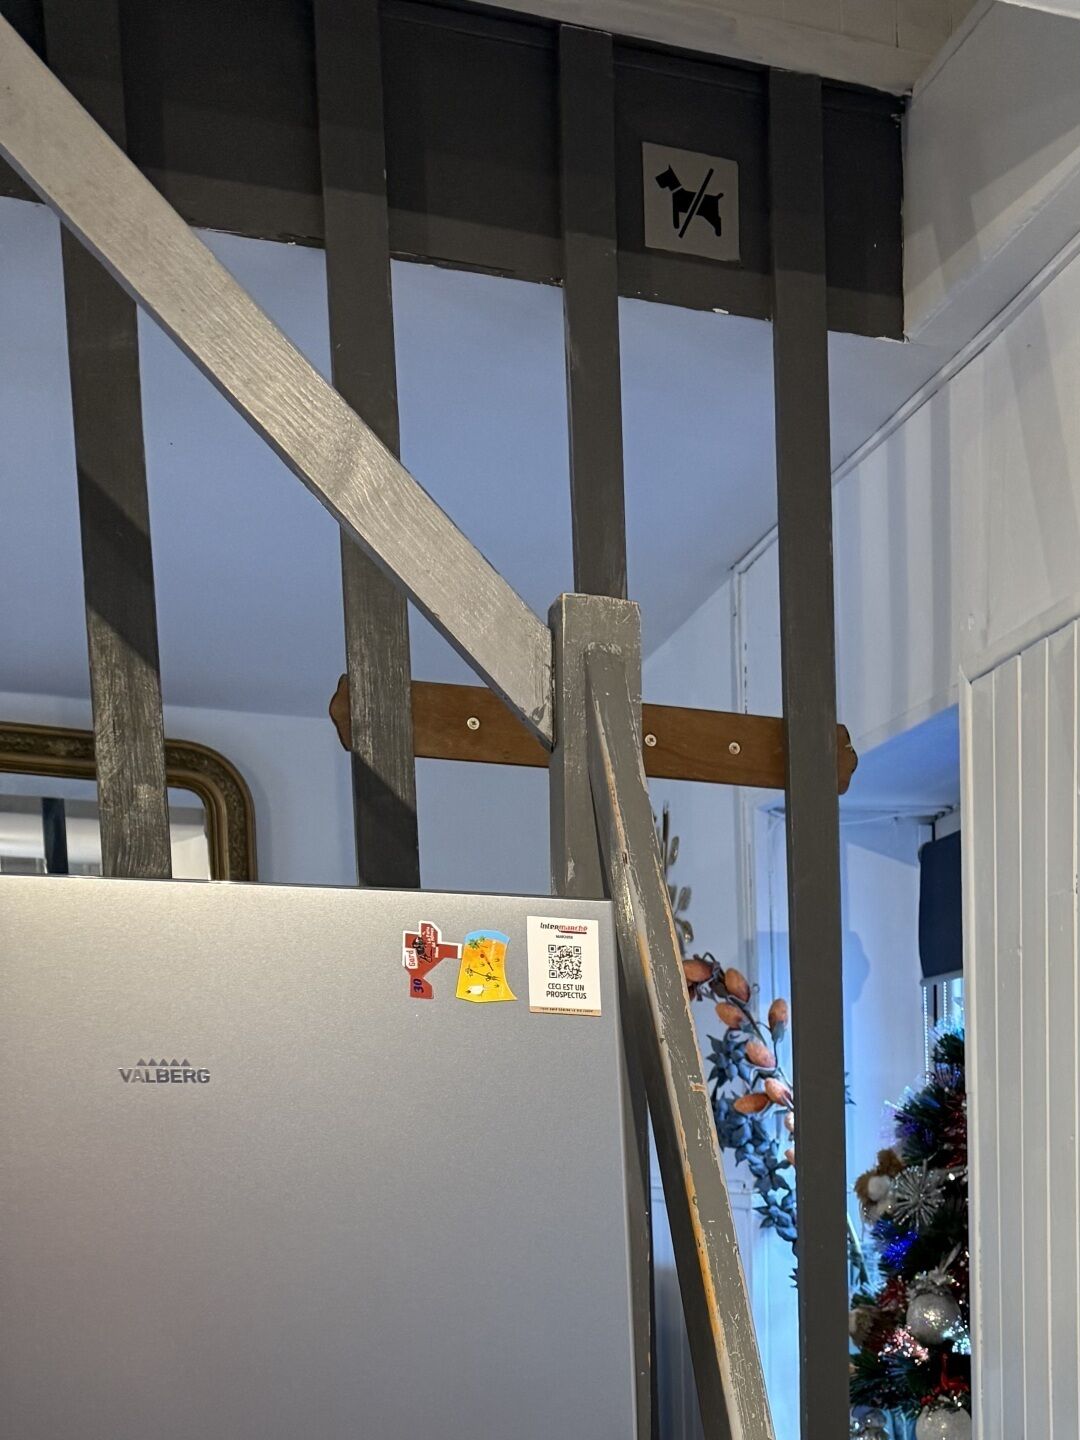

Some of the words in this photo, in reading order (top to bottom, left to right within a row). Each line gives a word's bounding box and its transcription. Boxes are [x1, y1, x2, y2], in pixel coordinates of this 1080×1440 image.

[406, 949, 416, 967] Gard
[413, 978, 425, 994] 30
[547, 982, 561, 990] CECI
[562, 983, 574, 991] EST
[546, 990, 587, 1000] PROSPECTUS
[118, 1068, 211, 1084] VALBERG
